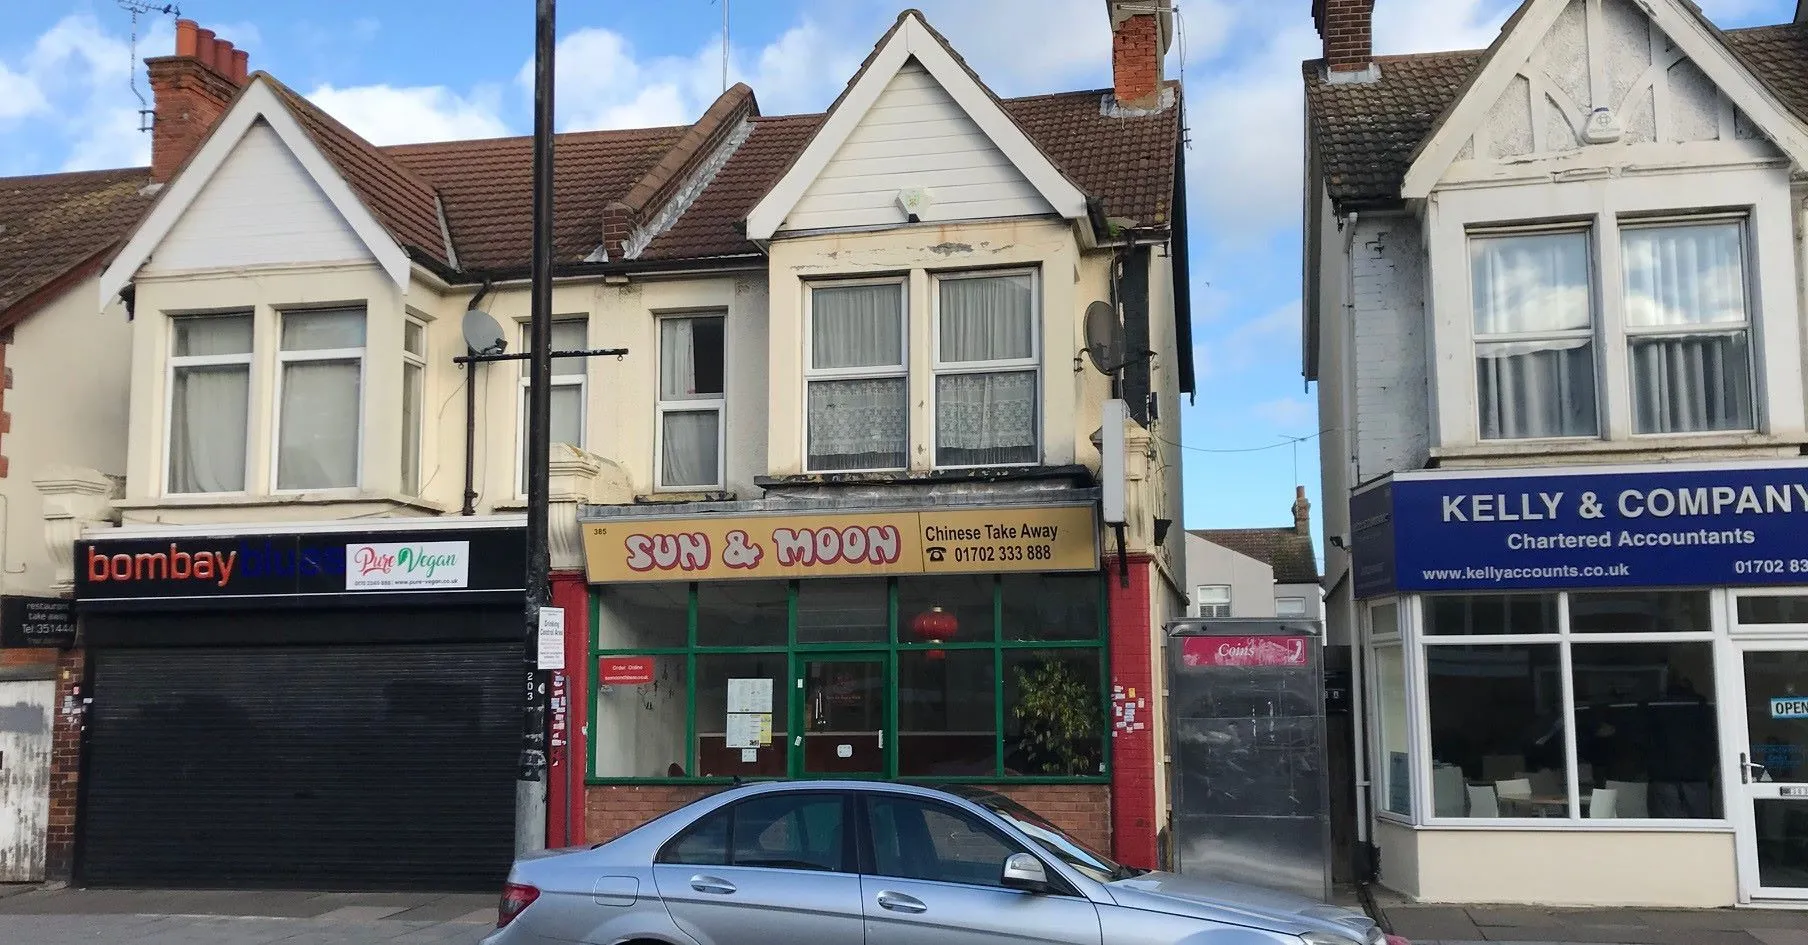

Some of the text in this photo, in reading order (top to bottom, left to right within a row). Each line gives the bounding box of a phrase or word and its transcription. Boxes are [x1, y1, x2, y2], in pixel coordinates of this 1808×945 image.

[1442, 492, 1563, 522] KELLY
[1579, 491, 1605, 518] &
[925, 523, 1058, 541] Chinese Take Away
[1508, 528, 1755, 550] Chartered Accountants
[624, 525, 901, 572] SUN & MOON
[955, 545, 1051, 562] 01702 333 888
[88, 543, 237, 588] bombay
[354, 546, 456, 578] Pure Vegan
[1423, 559, 1808, 582] www.kellyaccounts.co.uk 01702 83
[1218, 643, 1255, 657] Coins
[1775, 702, 1808, 715] OPEN
